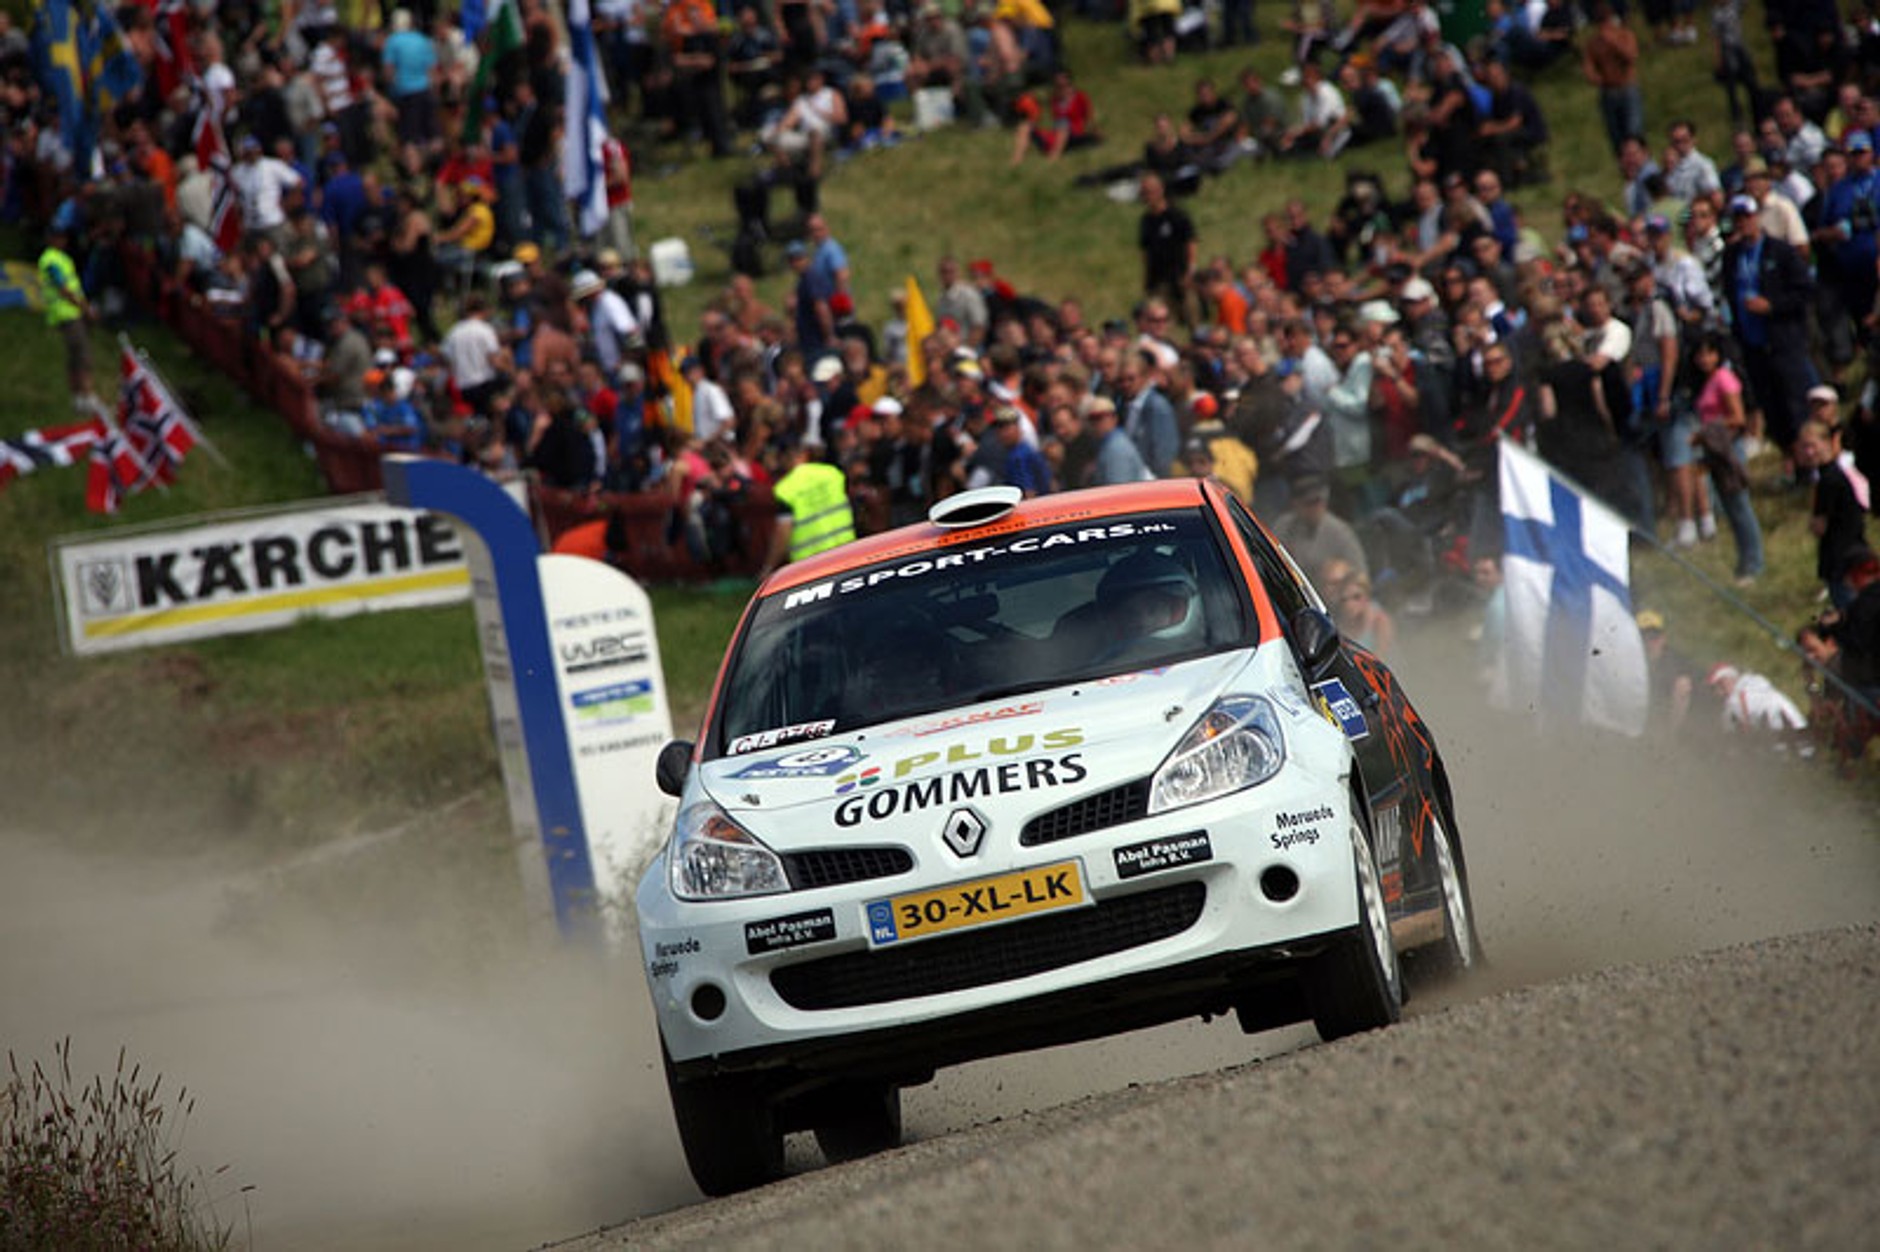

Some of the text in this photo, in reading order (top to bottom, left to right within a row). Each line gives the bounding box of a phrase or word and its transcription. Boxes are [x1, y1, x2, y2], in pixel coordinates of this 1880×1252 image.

[894, 727, 1085, 777] PLUS
[834, 753, 1087, 828] GOMMERS
[1117, 835, 1207, 864] Abel Pasman
[1270, 827, 1320, 850] Springs
[901, 872, 1073, 929] 30-XL-LK
[875, 926, 895, 940] NL
